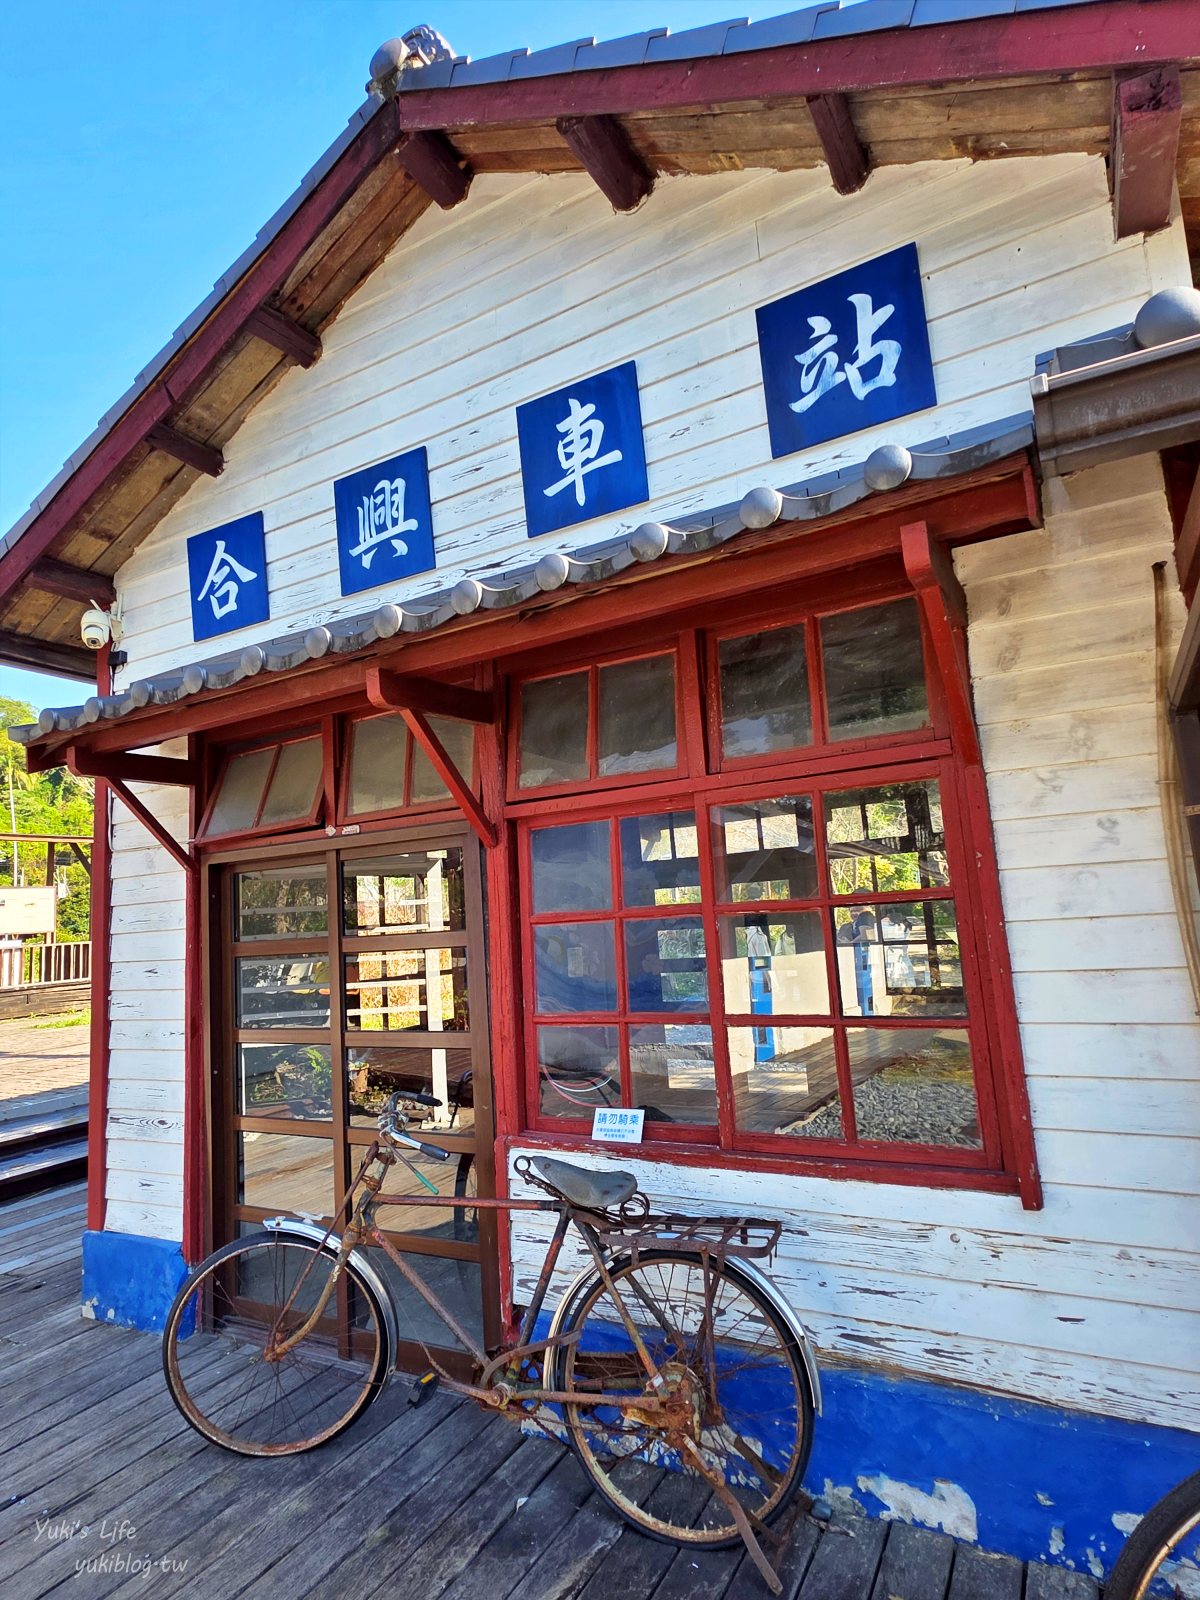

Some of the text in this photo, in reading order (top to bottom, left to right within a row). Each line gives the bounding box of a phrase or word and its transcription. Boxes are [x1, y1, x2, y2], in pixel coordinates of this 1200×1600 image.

[197, 293, 902, 620] 合 興 車 站
